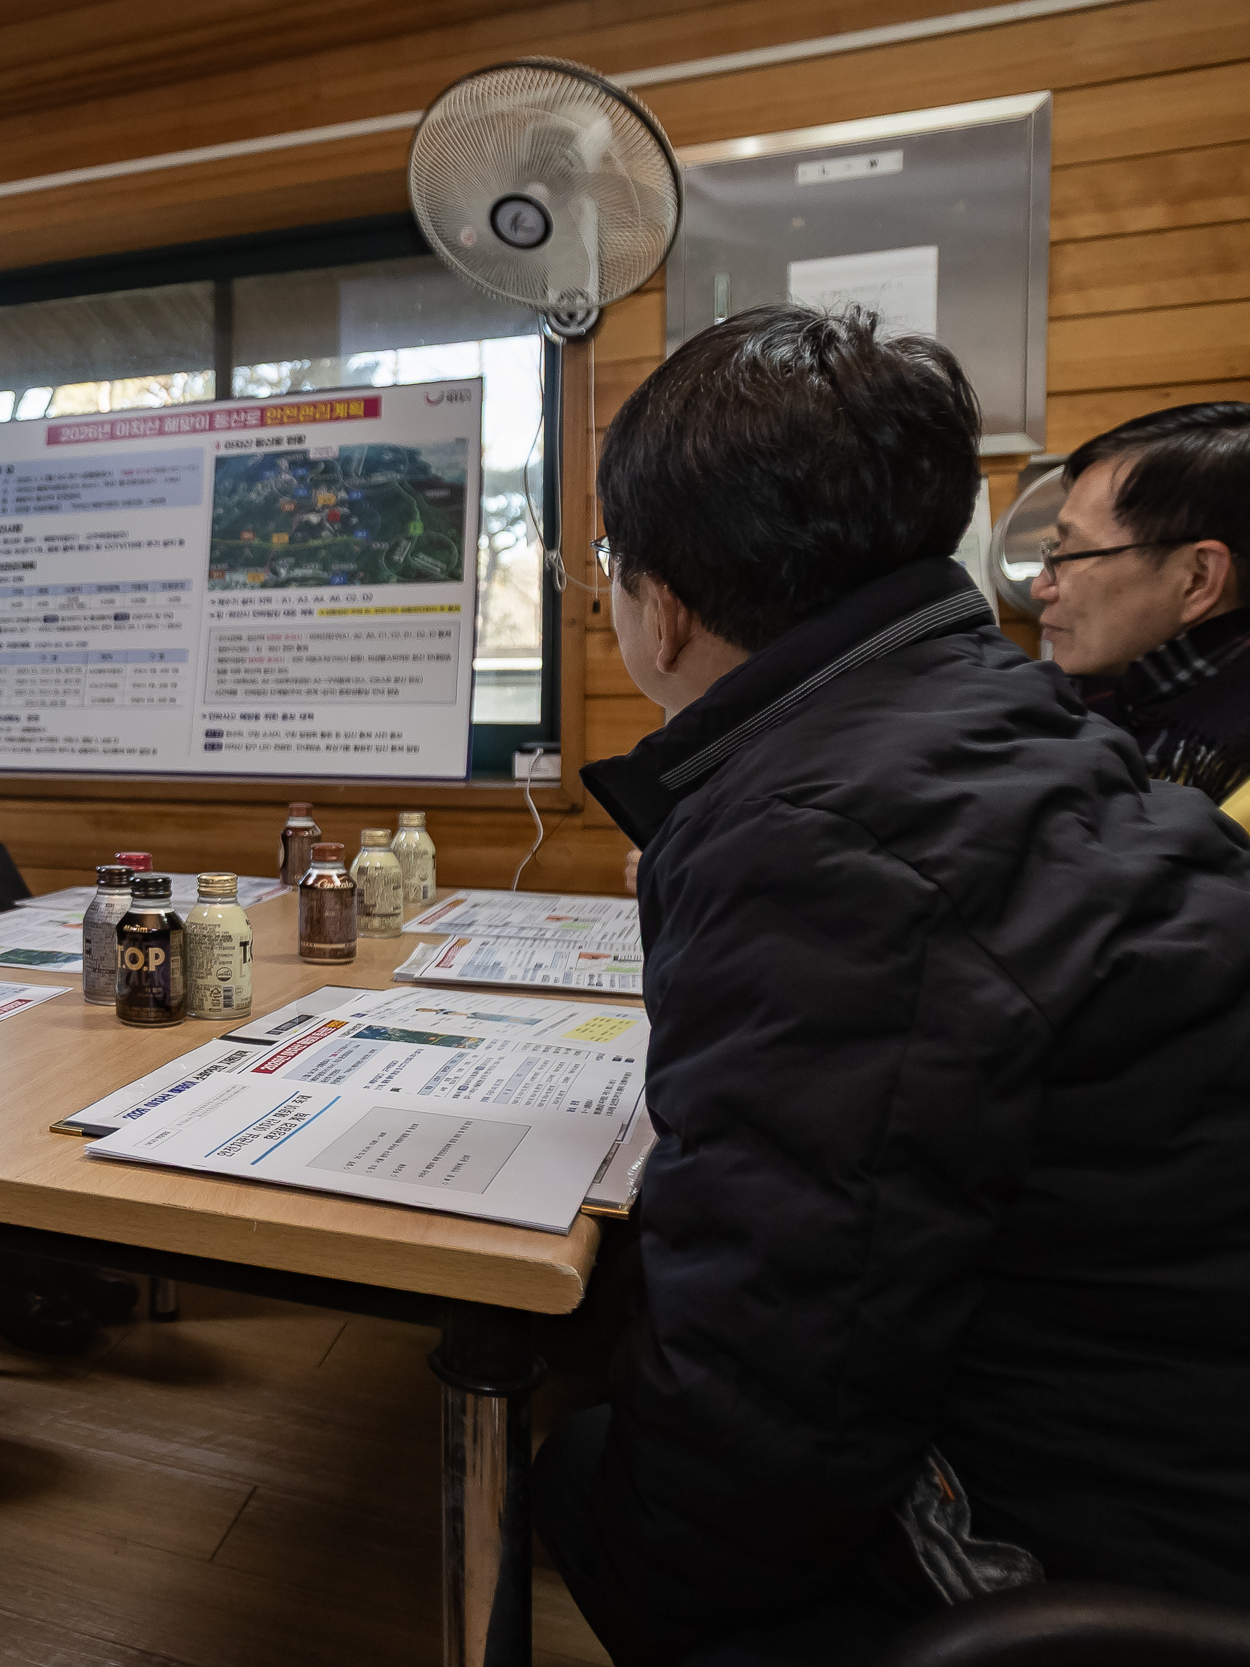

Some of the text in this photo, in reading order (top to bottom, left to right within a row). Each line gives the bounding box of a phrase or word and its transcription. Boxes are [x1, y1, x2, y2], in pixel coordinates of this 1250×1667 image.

[60, 400, 365, 441] 2026년 아차산 해맞이 등산로 안전관리계획
[122, 924, 148, 934] Maxim
[116, 946, 166, 972] T.O.P
[253, 1116, 281, 1135] 아차산
[273, 1103, 299, 1124] 해맞이
[289, 1112, 311, 1124] 계획
